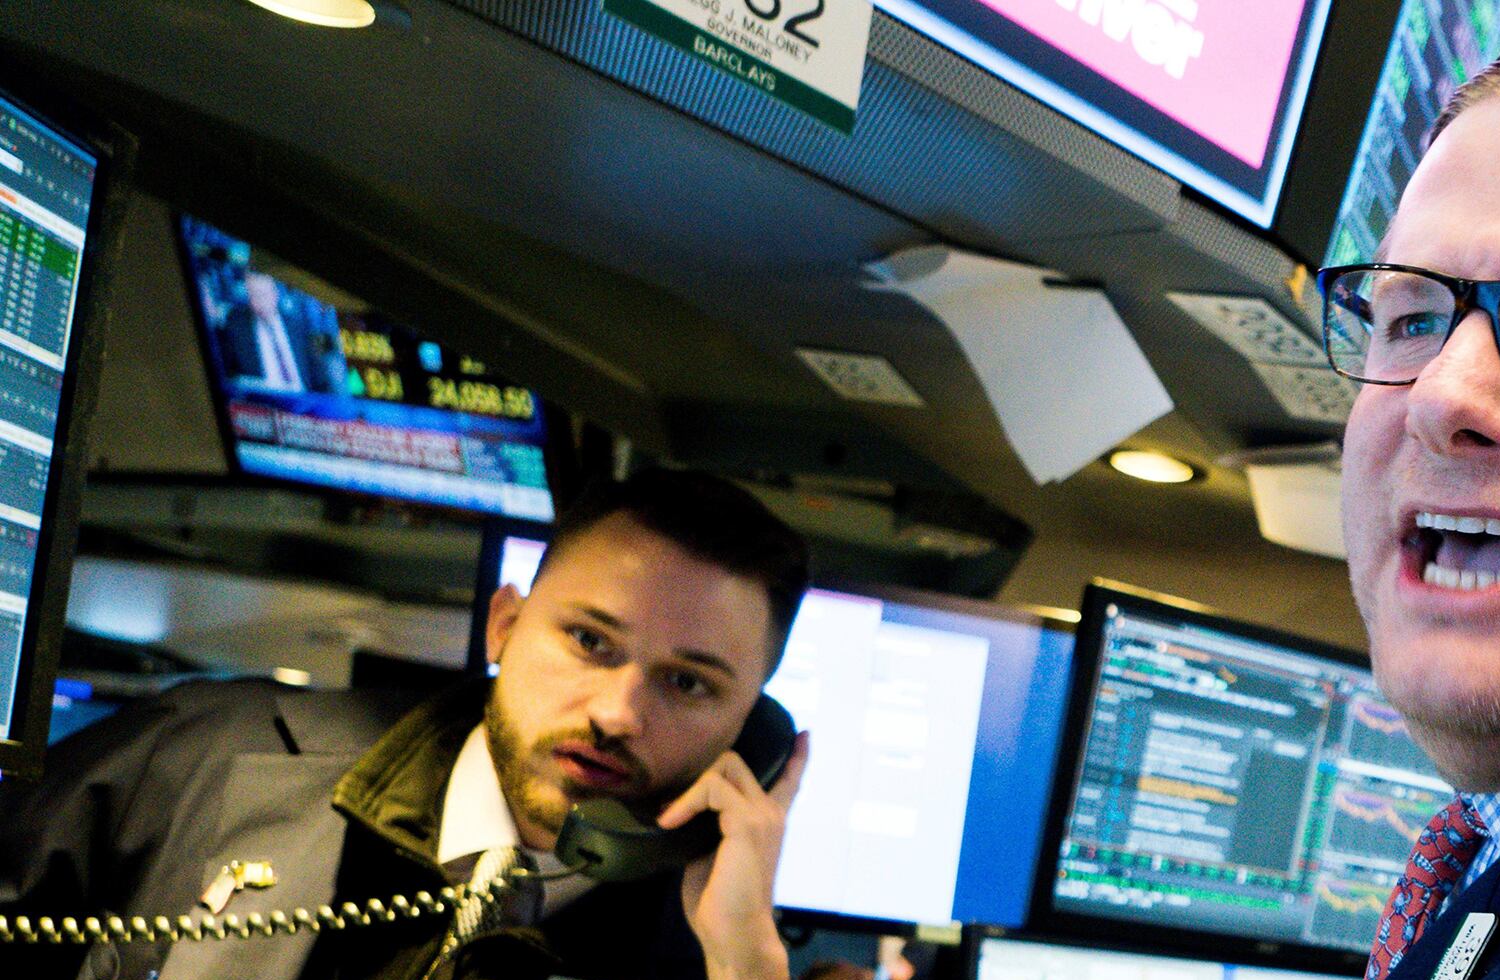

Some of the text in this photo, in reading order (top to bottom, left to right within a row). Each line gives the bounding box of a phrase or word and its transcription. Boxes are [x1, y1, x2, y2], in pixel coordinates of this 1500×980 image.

[706, 16, 773, 59] GOVERNOR
[742, 15, 812, 63] MALONEY
[693, 34, 776, 91] BARCLAYS
